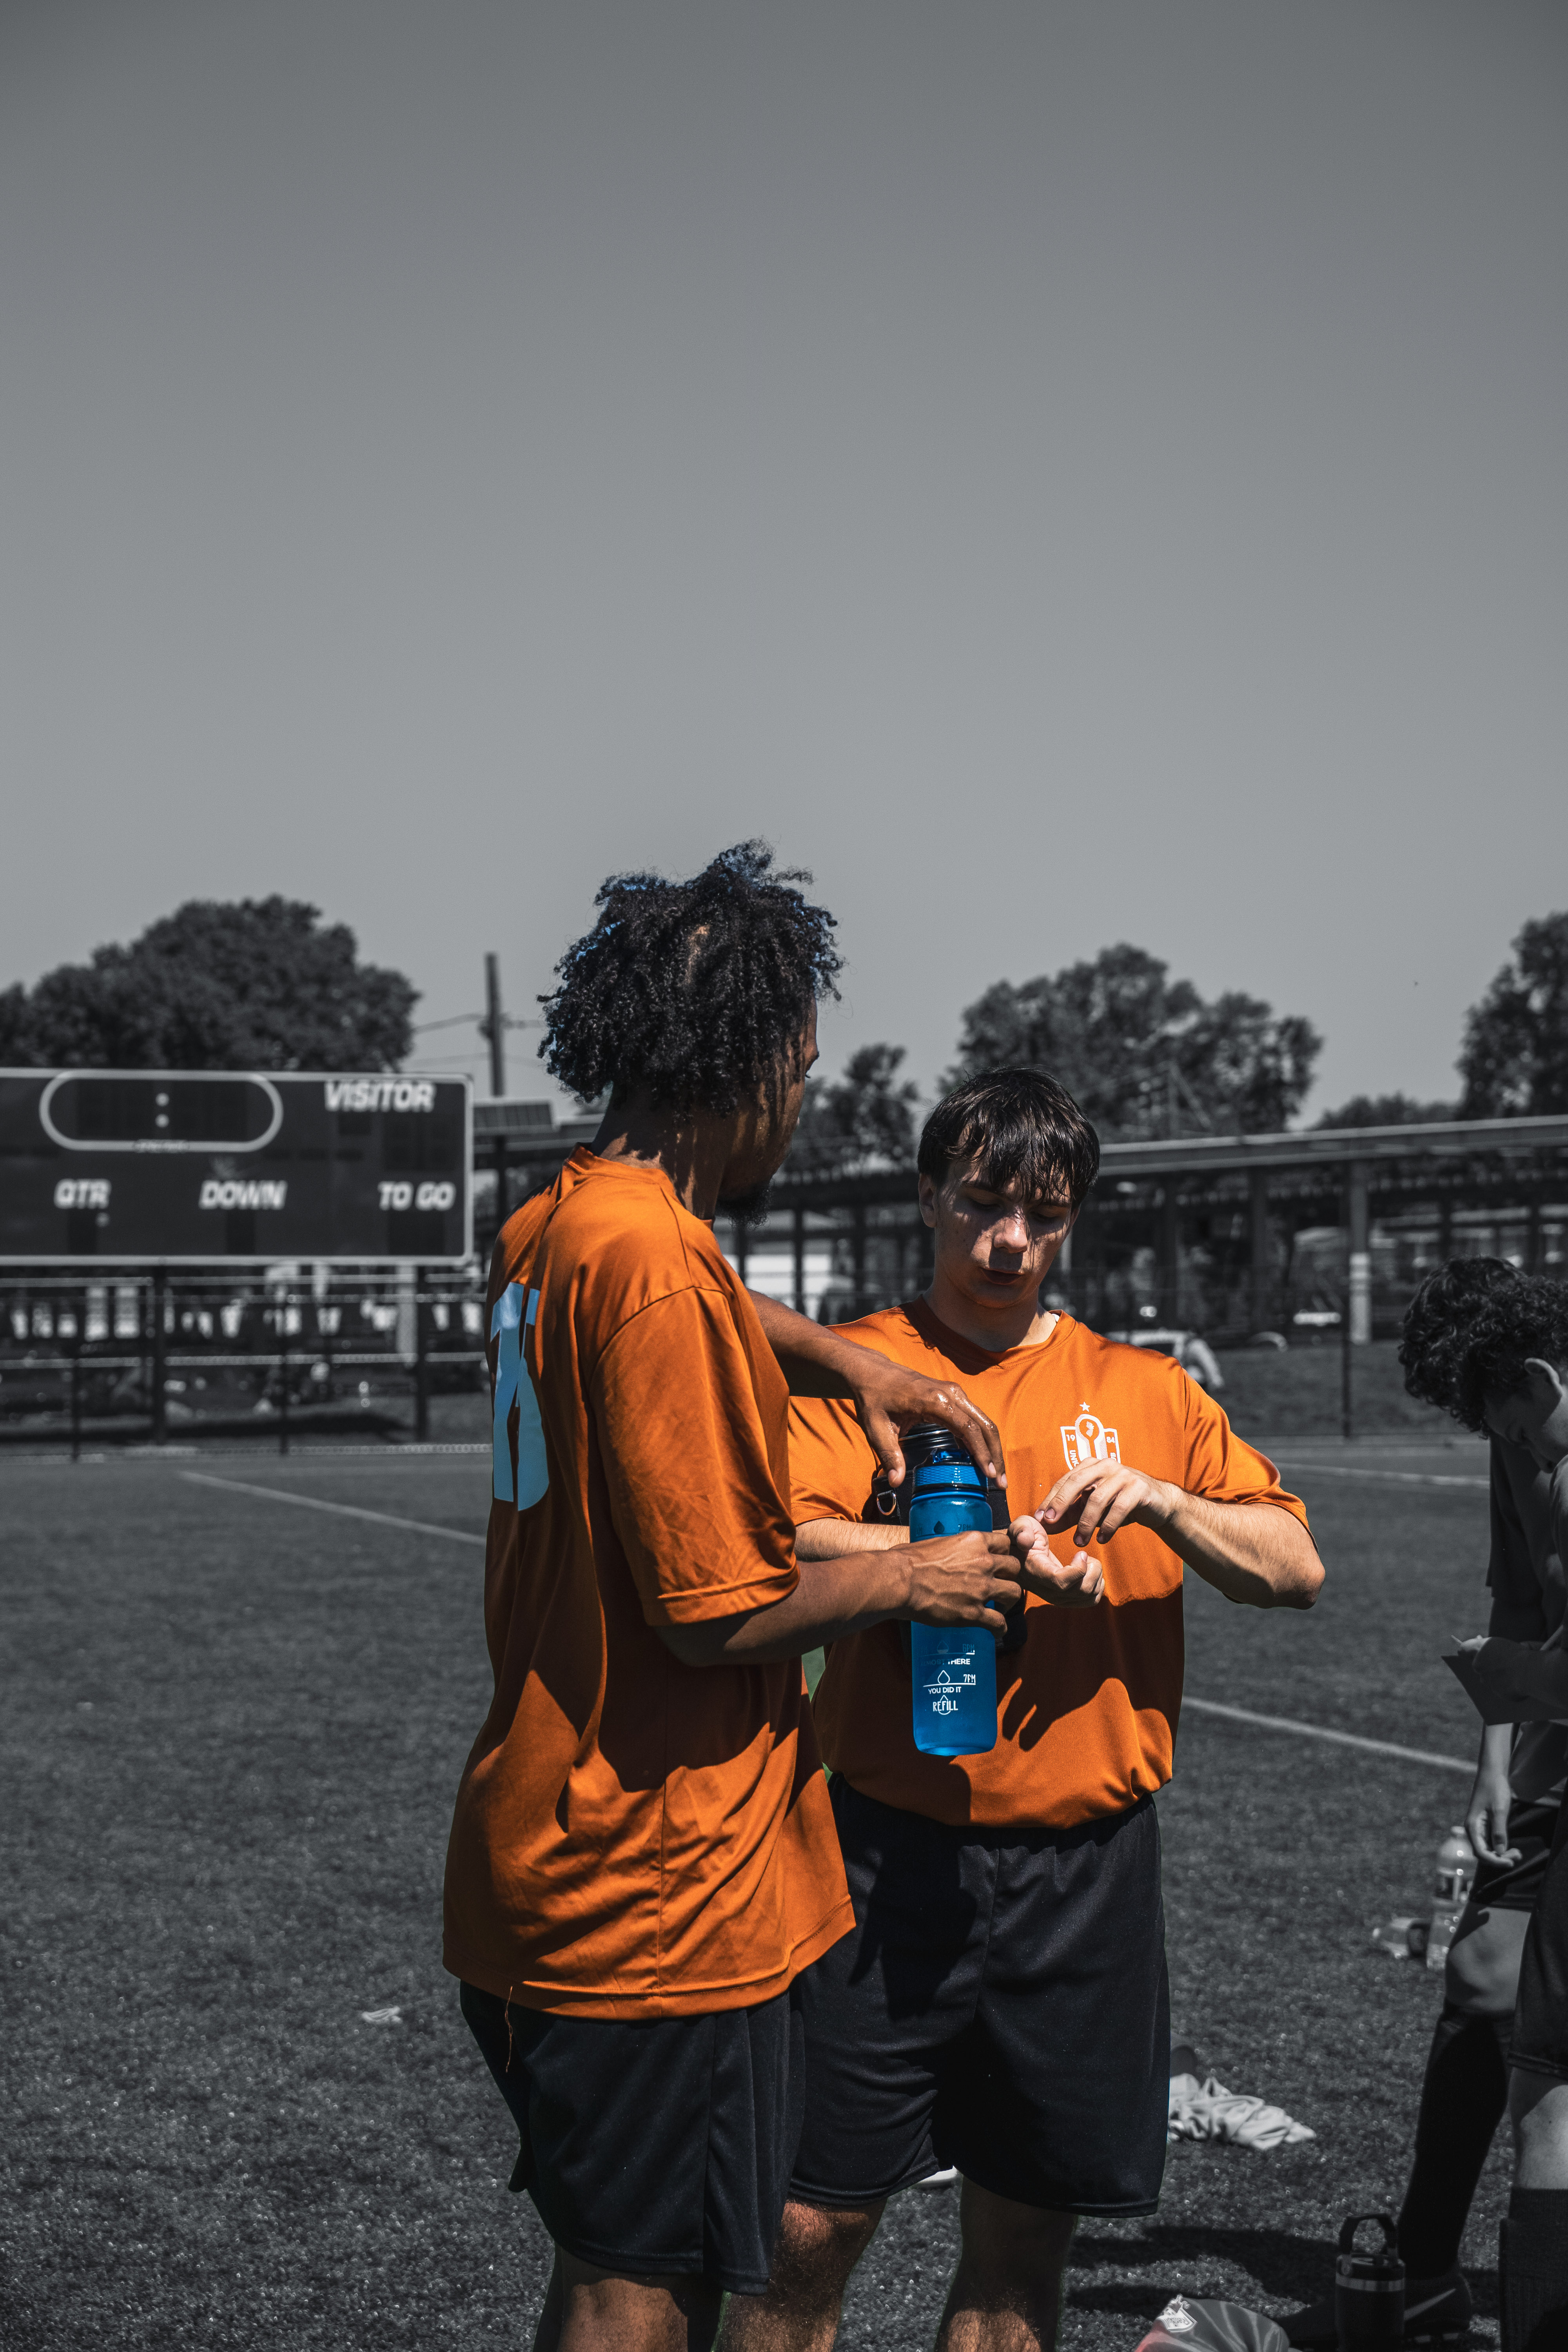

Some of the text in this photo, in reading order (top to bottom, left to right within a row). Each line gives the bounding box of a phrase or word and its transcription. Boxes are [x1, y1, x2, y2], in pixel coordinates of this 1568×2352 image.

[325, 1081, 435, 1112] VISITOR
[54, 1180, 110, 1209] QTR
[200, 1181, 286, 1210] DOWN
[379, 1182, 455, 1210] TO GO
[963, 1644, 975, 1653] 6PM
[933, 1700, 958, 1711] REFILL
